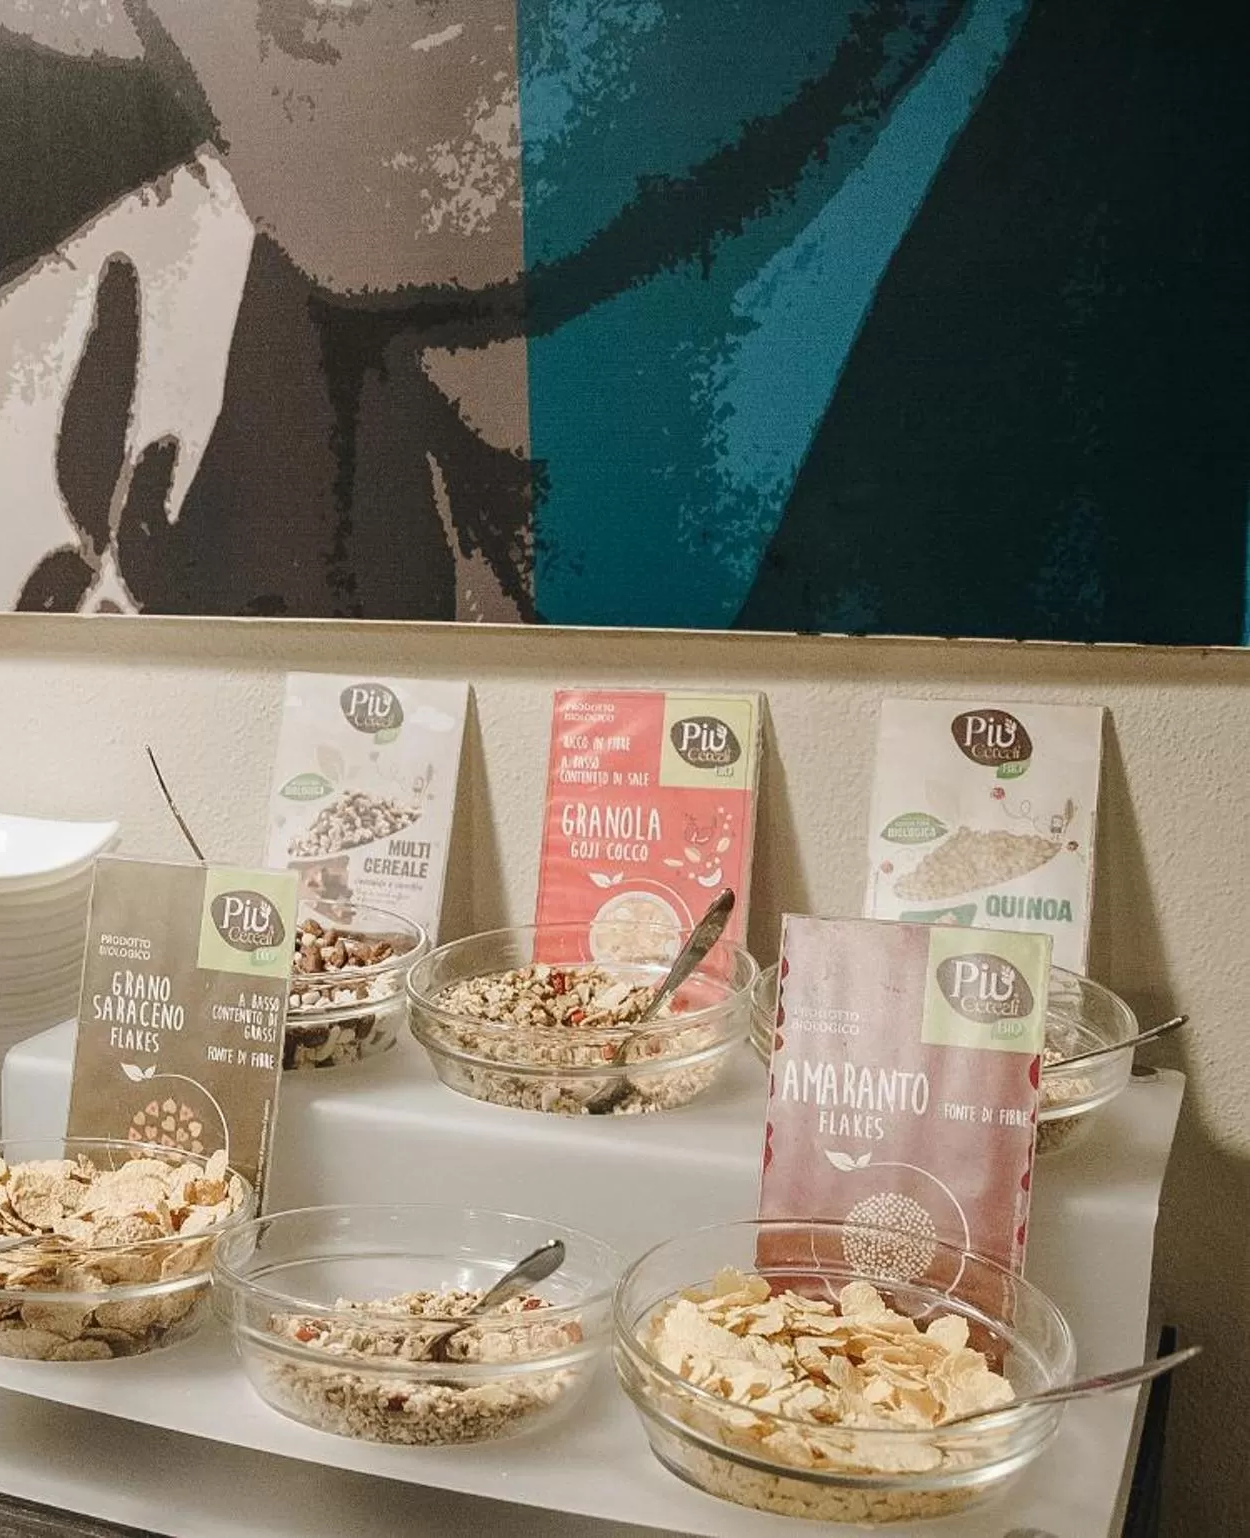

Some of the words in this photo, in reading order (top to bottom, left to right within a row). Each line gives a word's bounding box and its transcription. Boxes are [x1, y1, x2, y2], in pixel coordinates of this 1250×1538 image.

[628, 772, 650, 786] SALE
[561, 802, 662, 842] GRANOLA
[388, 840, 431, 859] MULTI
[570, 841, 599, 861] GOJI
[607, 842, 649, 862] COCCO
[363, 858, 429, 879] CEREALE
[984, 895, 1073, 923] QUINOA
[100, 934, 151, 948] PRODOTTO
[100, 945, 151, 961] BIOLOGICO
[112, 970, 171, 1001] GRANO
[92, 994, 185, 1031] SARACENO
[239, 993, 246, 1008] A
[251, 994, 280, 1011] BASSO
[212, 1005, 263, 1025] CONTENUTO
[268, 1013, 278, 1028] DI
[792, 1007, 860, 1023] PRODOTTO
[244, 1026, 277, 1043] GRASSI
[791, 1020, 861, 1037] BIOLOGICO
[110, 1027, 160, 1053] FLAKES
[207, 1045, 234, 1064] FONTE
[237, 1050, 247, 1065] DI
[251, 1052, 275, 1070] FIBRE
[781, 1059, 930, 1116] AMARANTO
[818, 1110, 885, 1141] FLAKES
[943, 1102, 976, 1123] FONTE
[981, 1107, 993, 1123] DI
[999, 1109, 1029, 1129] FIBRE
